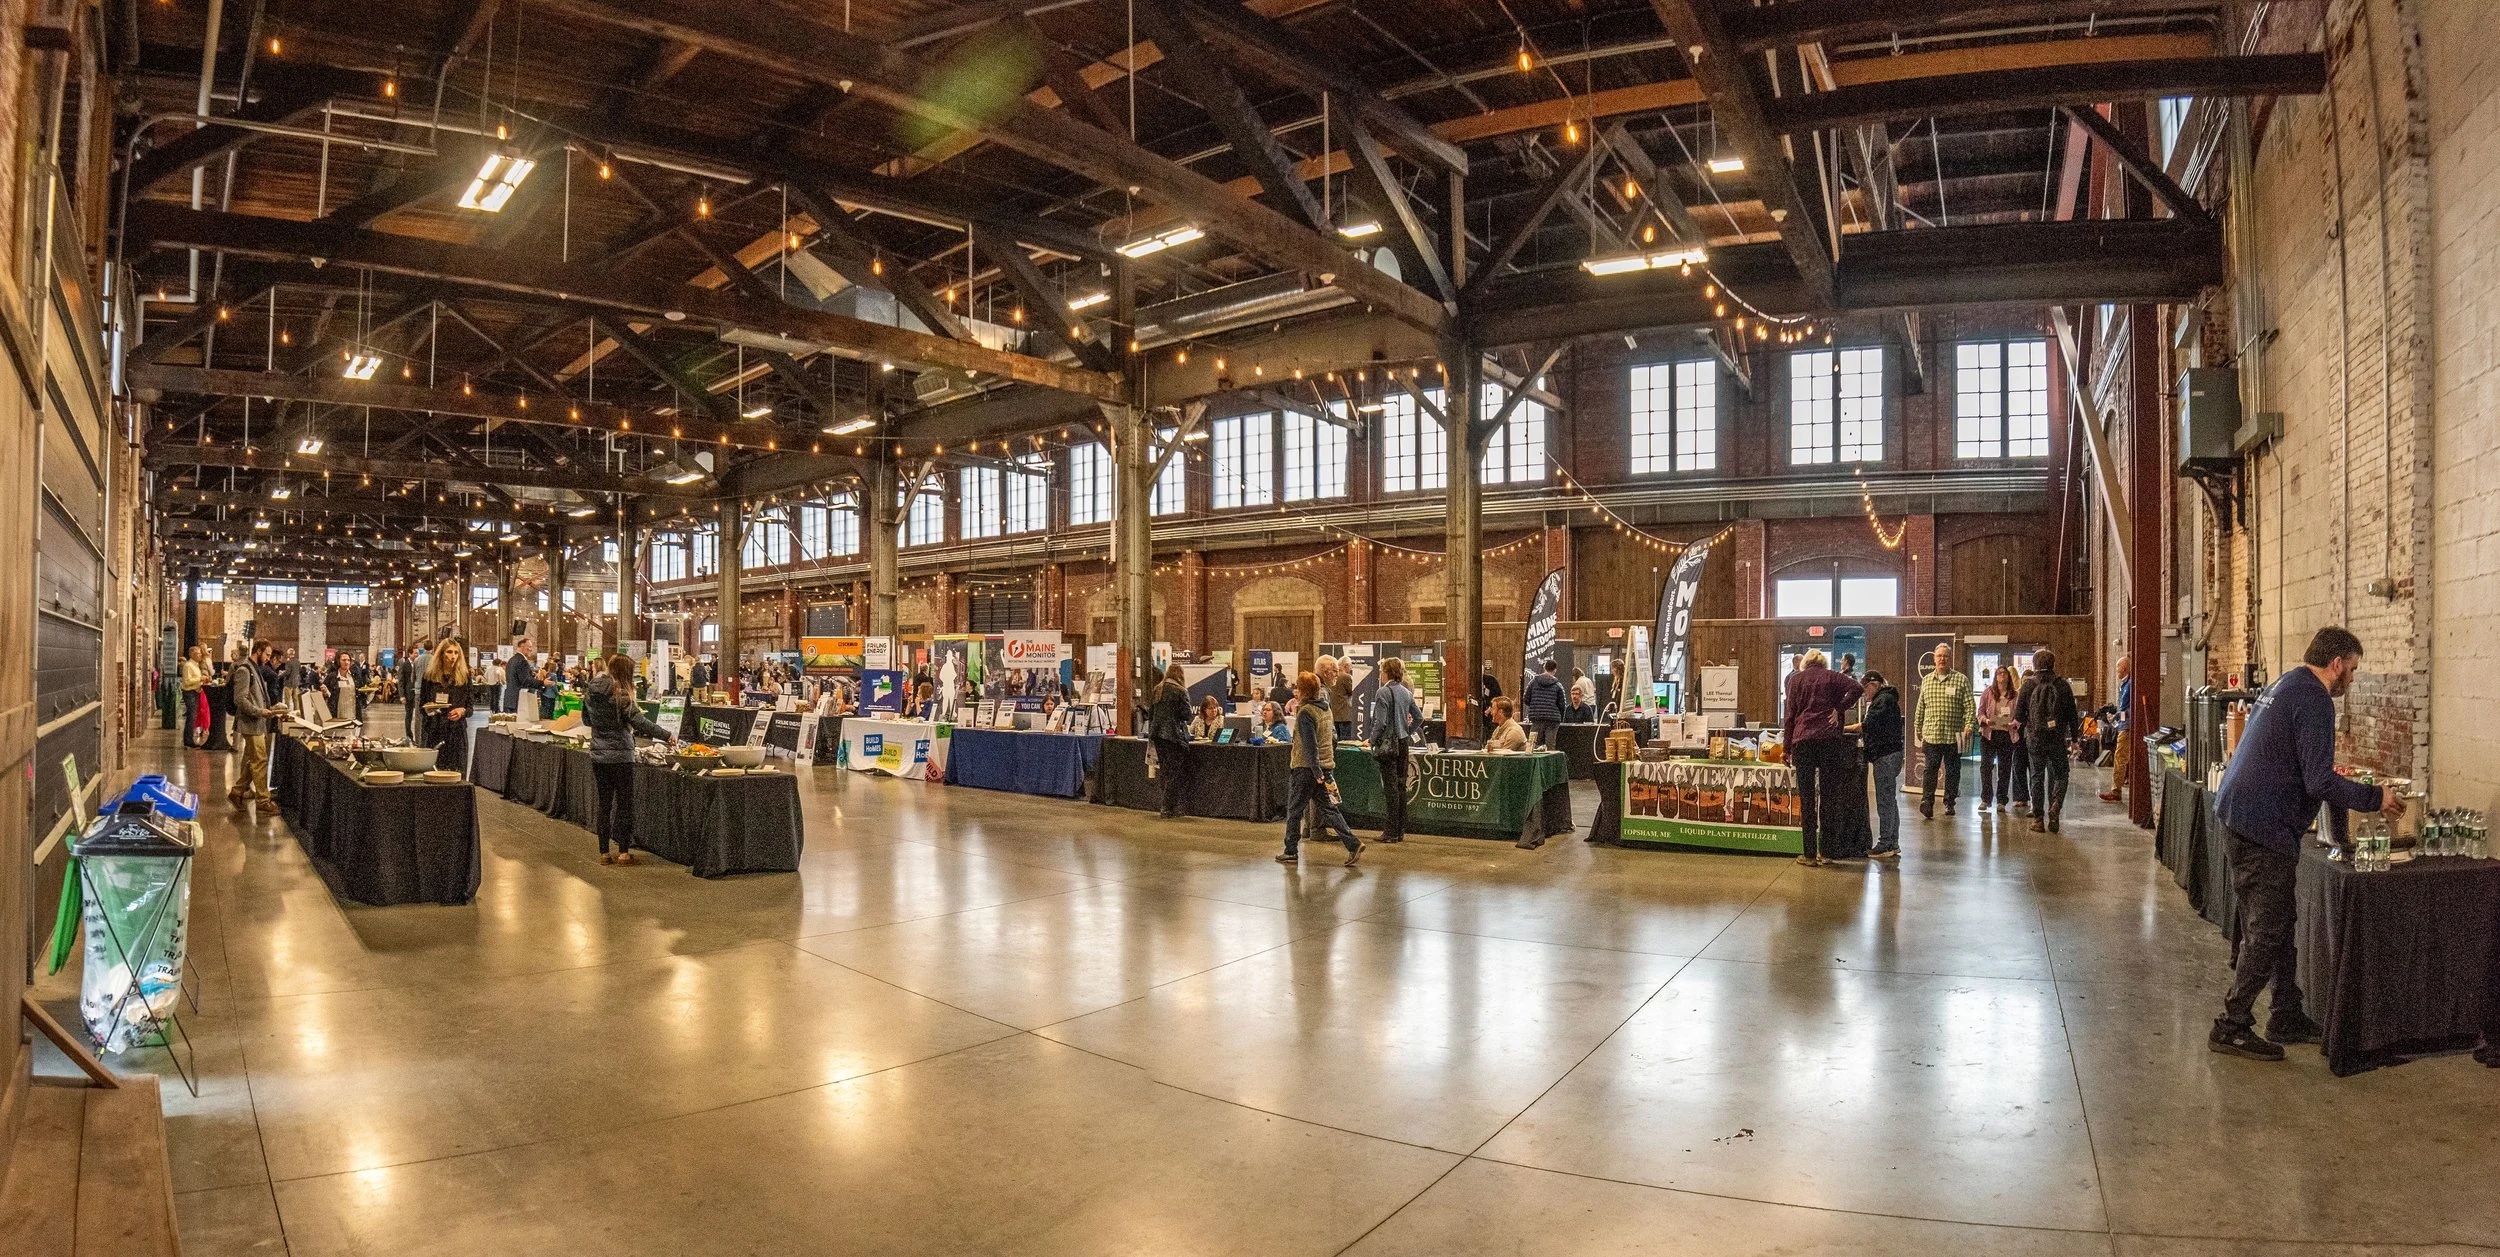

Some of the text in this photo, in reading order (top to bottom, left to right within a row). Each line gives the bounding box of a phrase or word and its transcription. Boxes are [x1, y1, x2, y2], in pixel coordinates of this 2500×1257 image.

[1527, 611, 1557, 640] MAINE
[1026, 644, 1056, 652] MAINE
[1525, 627, 1556, 651] OUTDOOR
[1525, 650, 1538, 660] FILM
[884, 748, 898, 757] BUILD
[1423, 754, 1489, 779] SIERRA
[1629, 762, 1739, 790] LONGVIEW
[1428, 776, 1481, 800] CLUB
[1427, 801, 1463, 810] FOUNDED
[1628, 777, 1727, 823] WORM
[1623, 828, 1672, 839] TOPSHAM, ME
[1679, 827, 1778, 841] LIQUID PLANT FERTILIZER
